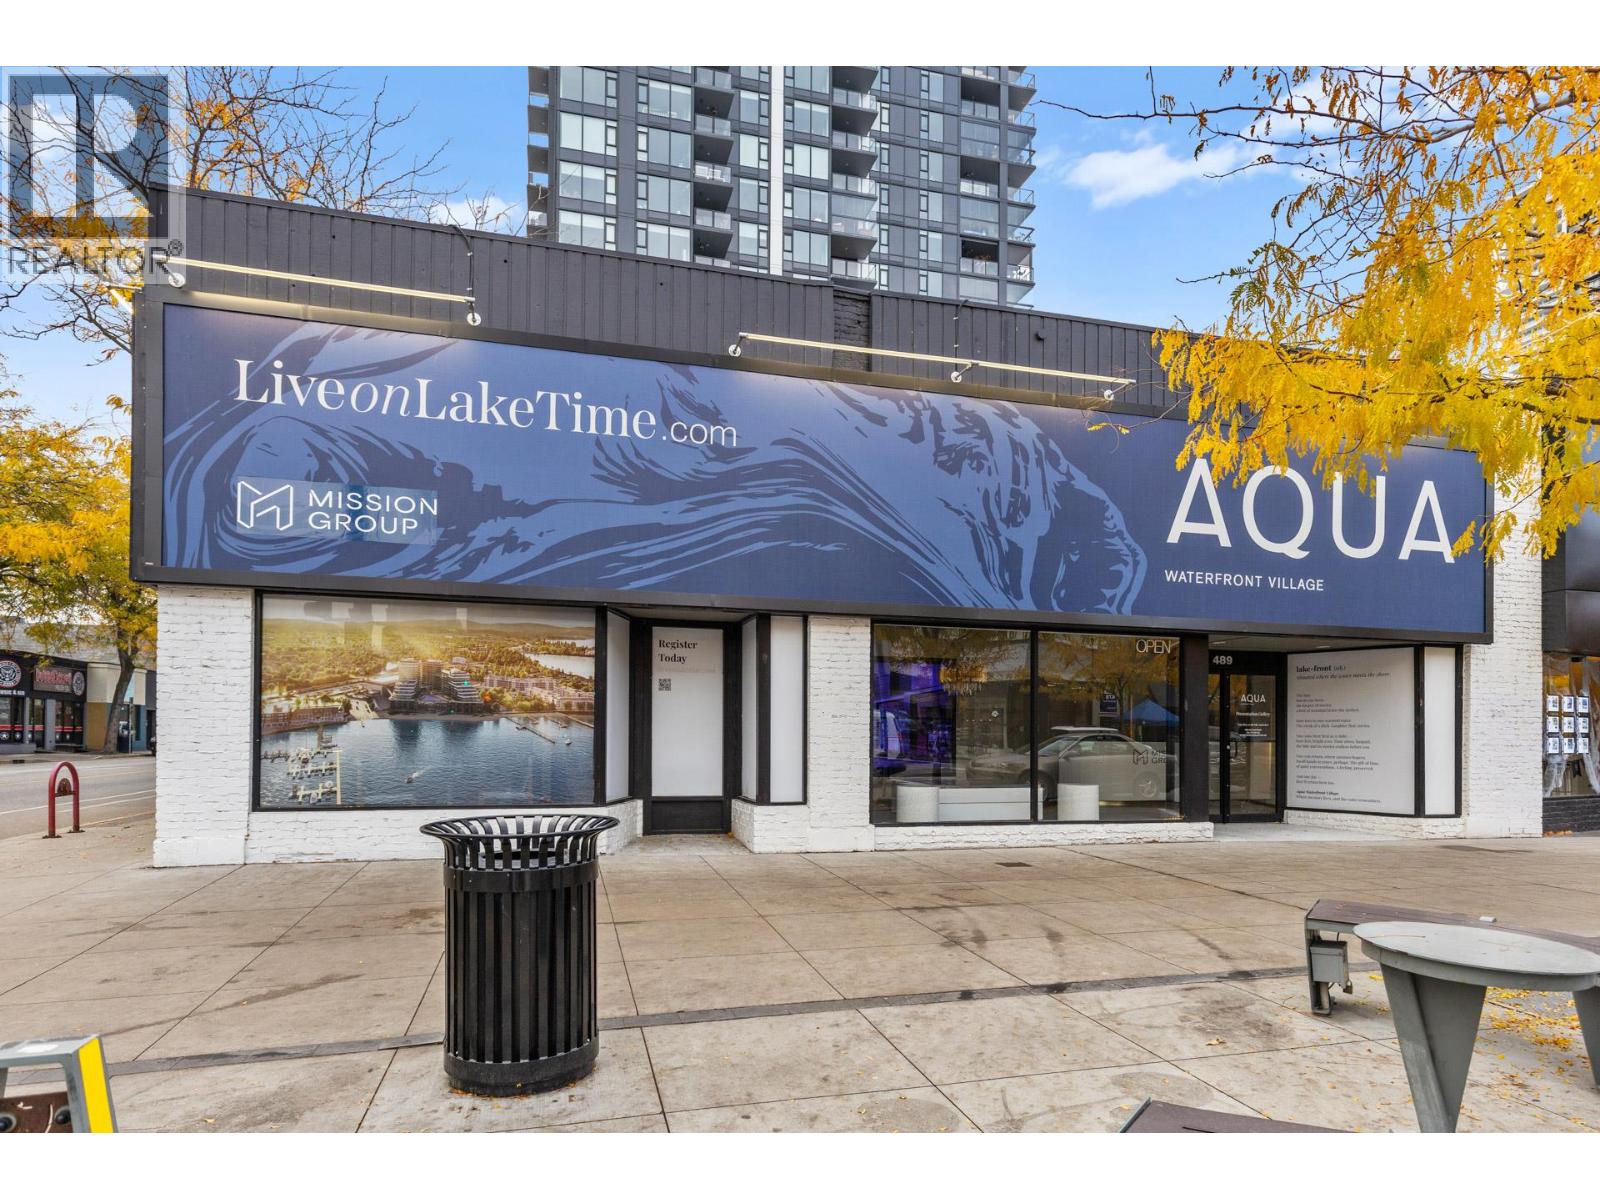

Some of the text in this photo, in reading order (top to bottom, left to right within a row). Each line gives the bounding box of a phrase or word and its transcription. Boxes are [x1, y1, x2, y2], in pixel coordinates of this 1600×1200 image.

[308, 489, 438, 516] MISSION
[1166, 457, 1456, 564] AQUA
[308, 511, 418, 535] GROUP
[1165, 569, 1324, 592] WATERFRONT VILLAGE
[658, 639, 698, 650] Register
[1135, 639, 1171, 654] OPEN
[658, 653, 688, 665] Today
[1212, 655, 1233, 665] 489
[1240, 694, 1266, 703] AQUA
